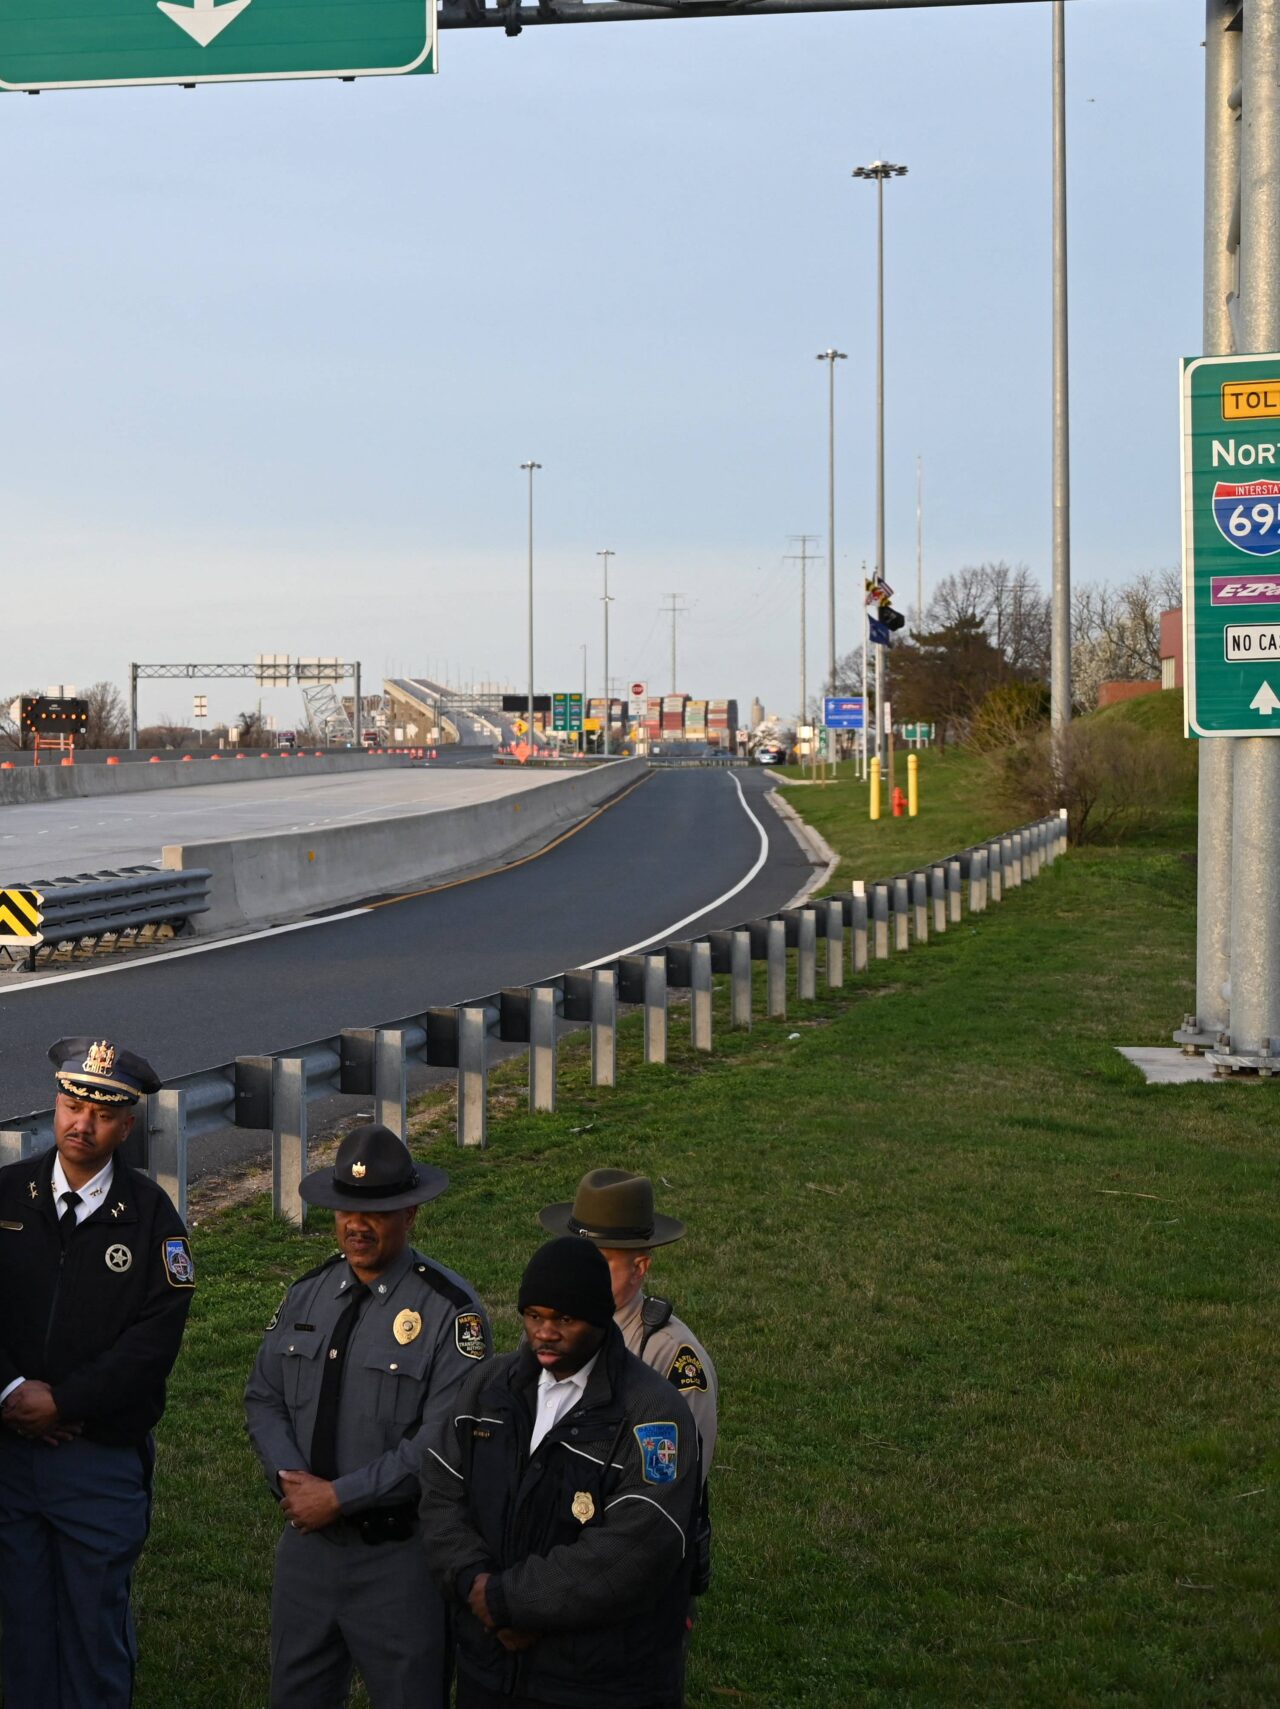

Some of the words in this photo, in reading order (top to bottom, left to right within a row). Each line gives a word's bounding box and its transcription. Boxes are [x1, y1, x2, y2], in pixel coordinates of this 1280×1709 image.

[1230, 391, 1280, 410] TOL
[1228, 503, 1280, 537] 69
[1232, 634, 1252, 652] NO
